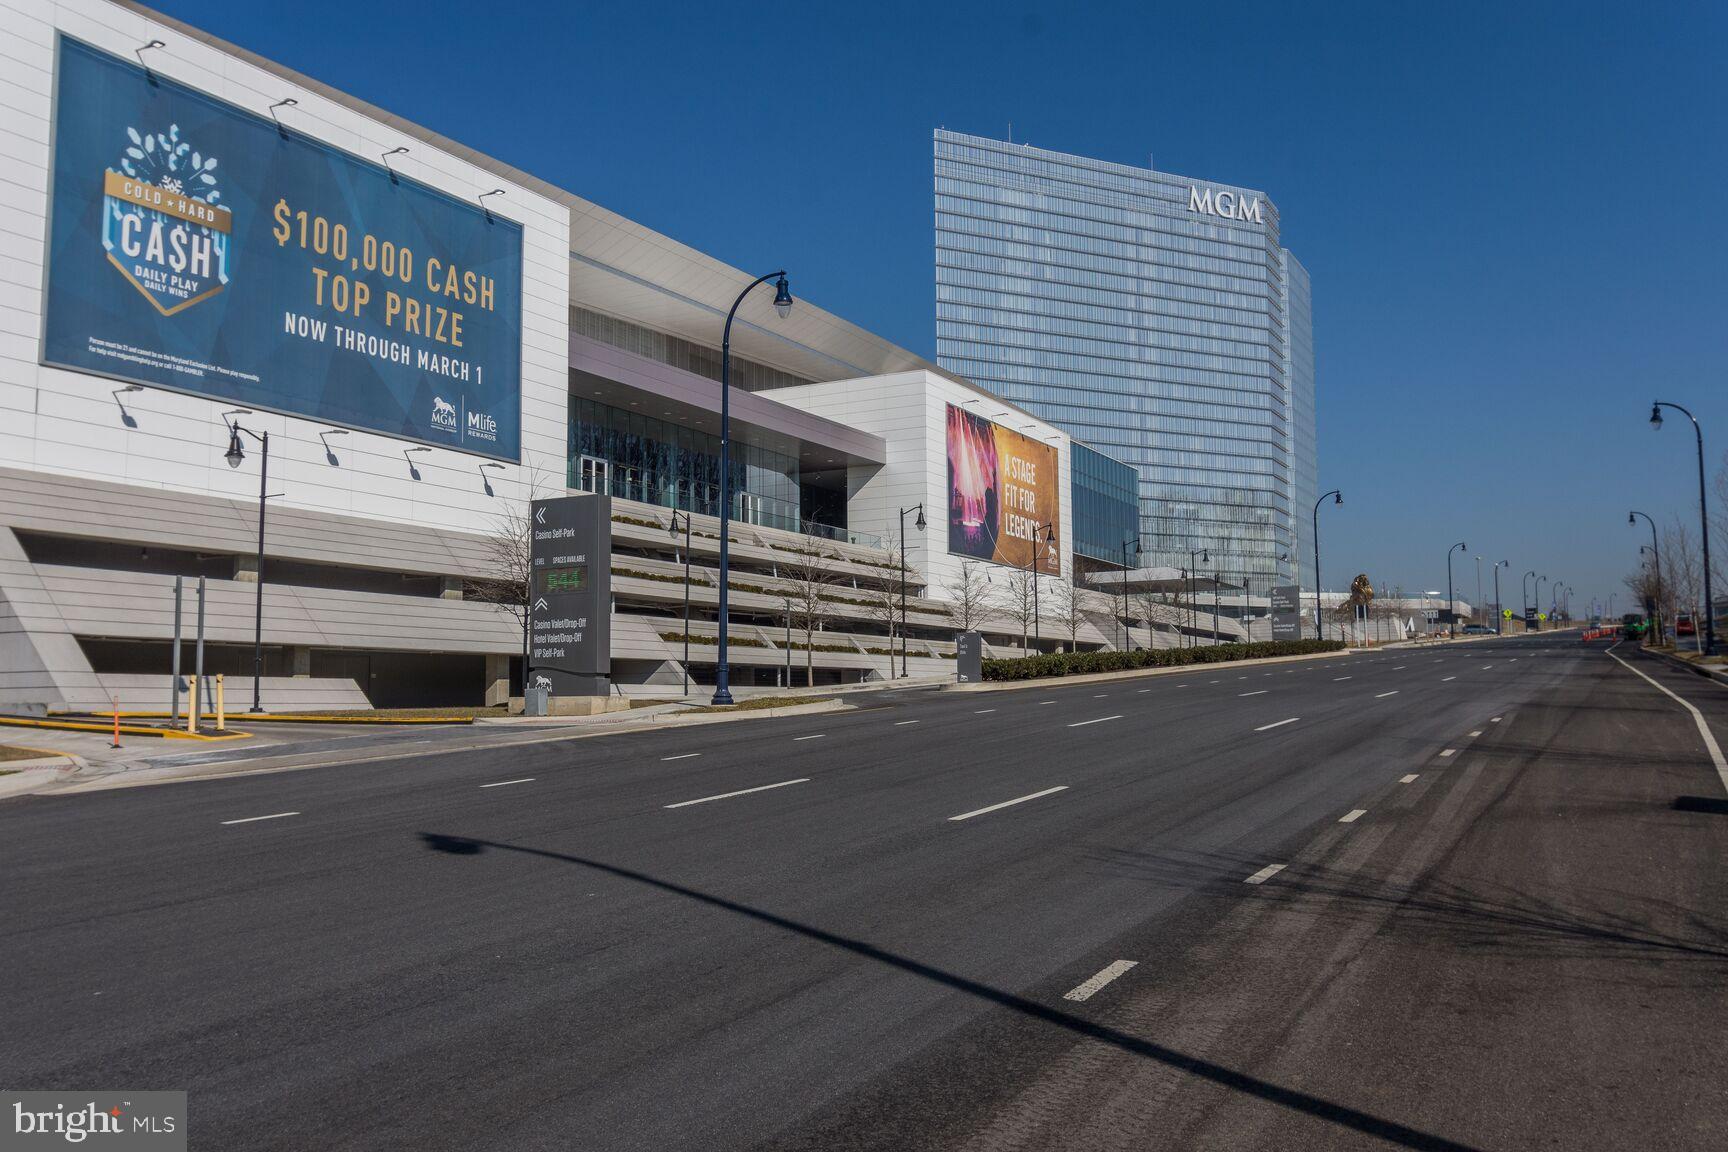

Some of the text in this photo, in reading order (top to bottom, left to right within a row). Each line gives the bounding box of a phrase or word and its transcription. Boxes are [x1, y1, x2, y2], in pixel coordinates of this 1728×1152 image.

[124, 182, 214, 222] COLD HARD
[1188, 185, 1263, 224] MGM
[121, 213, 211, 278] CA$H
[273, 198, 494, 312] $100,000 CASH
[134, 264, 199, 292] DAILY PLAY
[144, 281, 189, 299] DAILY WINS
[312, 267, 463, 348] TOP PRIZE
[285, 311, 482, 385] NOW THROUGH MARCH 1
[431, 412, 457, 427] MGM
[468, 411, 497, 433] Mlife
[467, 430, 497, 442] REWARDS
[1005, 453, 1036, 486] A STAGE
[1005, 483, 1036, 514] FIT FOR
[535, 527, 575, 540] Casino Self-Park
[534, 554, 586, 566] LEVEL SPACES AVAILABLE
[533, 620, 551, 630] Casino
[533, 634, 547, 644] Hotel
[534, 647, 565, 658] VIP Self-Park
